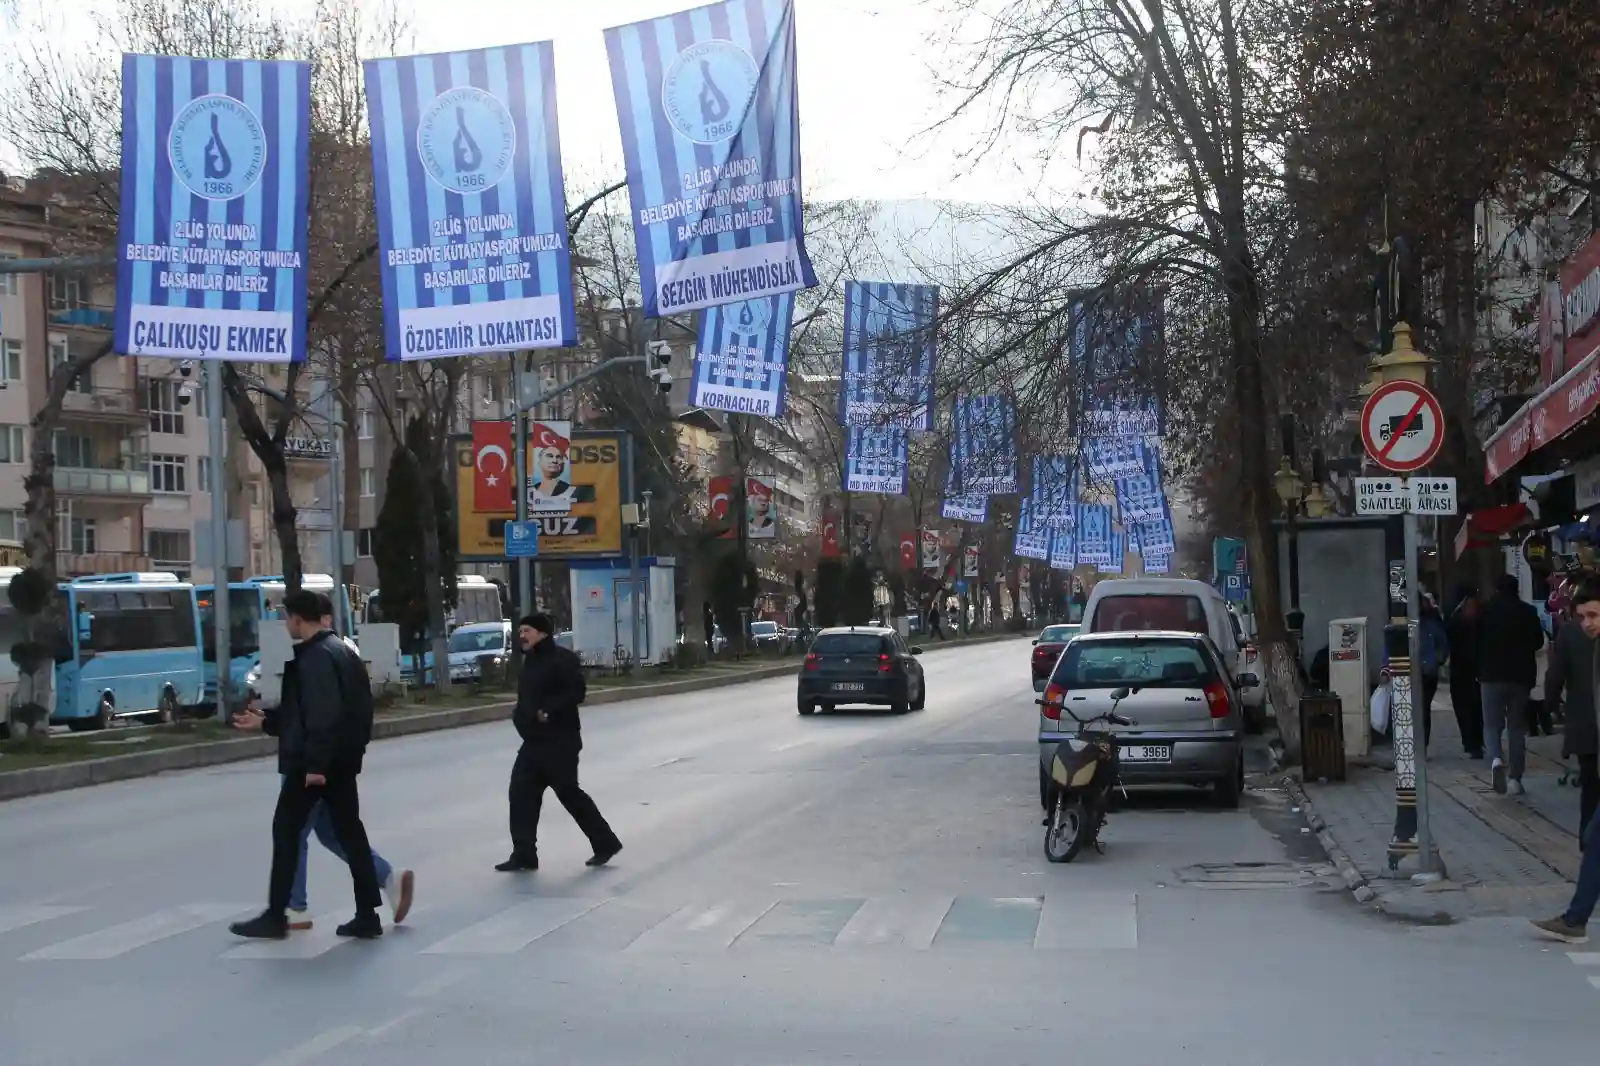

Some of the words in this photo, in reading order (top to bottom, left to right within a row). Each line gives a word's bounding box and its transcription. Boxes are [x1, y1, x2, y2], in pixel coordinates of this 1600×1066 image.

[704, 121, 733, 142] 1966
[204, 182, 233, 194] 1966
[456, 174, 485, 187] 1966
[640, 196, 693, 225] BELEDİYE
[735, 204, 774, 229] DİLERİZ
[175, 218, 204, 238] 2.LİG
[206, 223, 256, 241] YOLUNDA
[434, 214, 461, 236] 2.LİG
[464, 214, 514, 233] YOLUNDA
[126, 242, 179, 263] BELEDİYE
[388, 244, 441, 266] BELEDİYE
[160, 271, 223, 294] BAŞARILAR
[226, 271, 268, 292] DİLERİZ
[424, 269, 486, 293] BAŞARILAR
[489, 261, 531, 282] DİLERİZ
[662, 272, 708, 309] SEZGİN
[710, 256, 799, 300] MÜHENDİSLİK
[134, 320, 220, 356] ÇALIKUŞU
[227, 326, 287, 353] EKMEK
[406, 321, 474, 353] ÖZDEMİR
[479, 317, 557, 346] LOKANTASI
[702, 392, 770, 413] KORNACILAR
[862, 481, 876, 490] YAPI
[1418, 497, 1451, 510] ARASI
